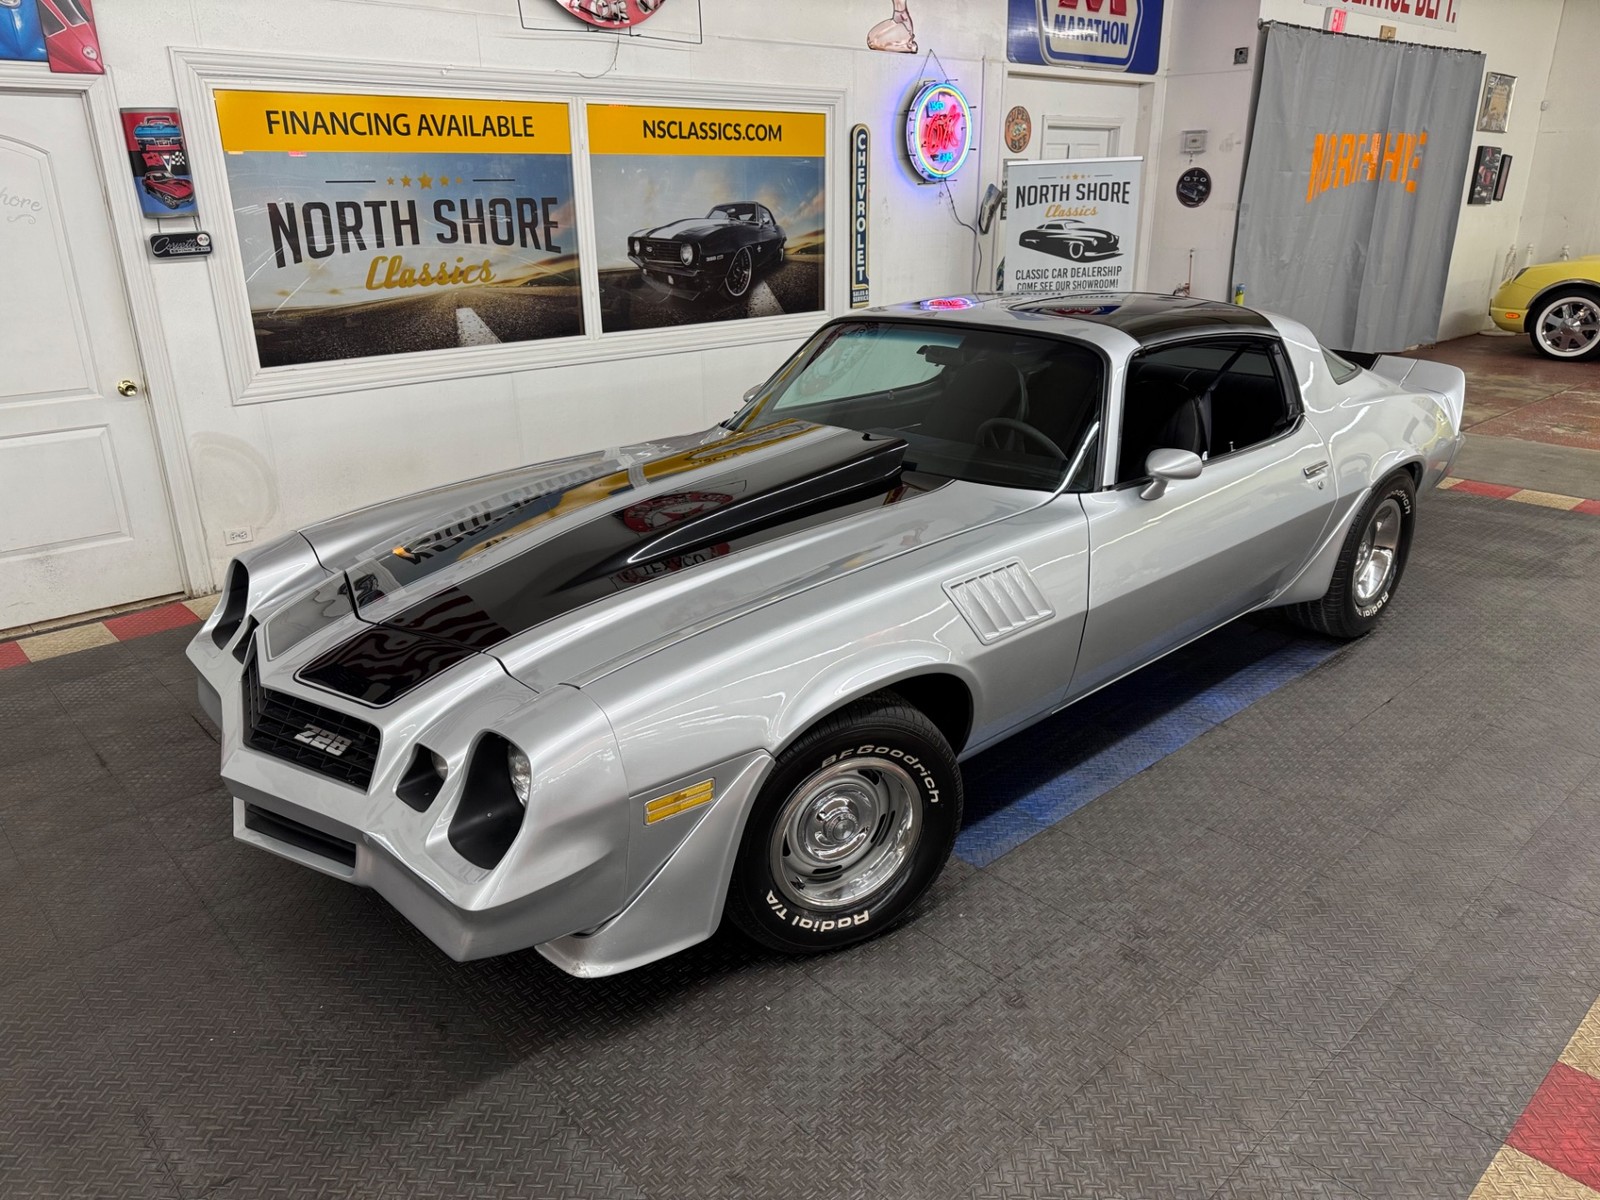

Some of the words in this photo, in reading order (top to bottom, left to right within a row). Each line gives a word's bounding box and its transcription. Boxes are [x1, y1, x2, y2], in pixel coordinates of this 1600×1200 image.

[1054, 14, 1129, 46] MARATHON
[265, 110, 411, 137] FINANCING
[417, 114, 535, 138] AVAILABLE
[643, 119, 782, 142] NSCLASSICS.COM
[857, 133, 867, 282] CHEVROLET
[1015, 184, 1071, 209] NORTH
[1076, 181, 1131, 205] SHORE
[1045, 204, 1098, 219] Classics
[267, 200, 421, 269] NORTH
[433, 197, 562, 254] SHORE
[365, 255, 496, 291] Classics
[1015, 268, 1049, 281] CLASSIC
[1052, 268, 1068, 279] CAR
[1071, 265, 1122, 279] DEALERSHIP
[1040, 281, 1053, 291] SEE
[1055, 280, 1070, 291] OUR
[1072, 279, 1118, 290] SHOWROOM!
[294, 723, 352, 757] Z28
[766, 890, 788, 920] T/A
[791, 910, 870, 932] Radial
